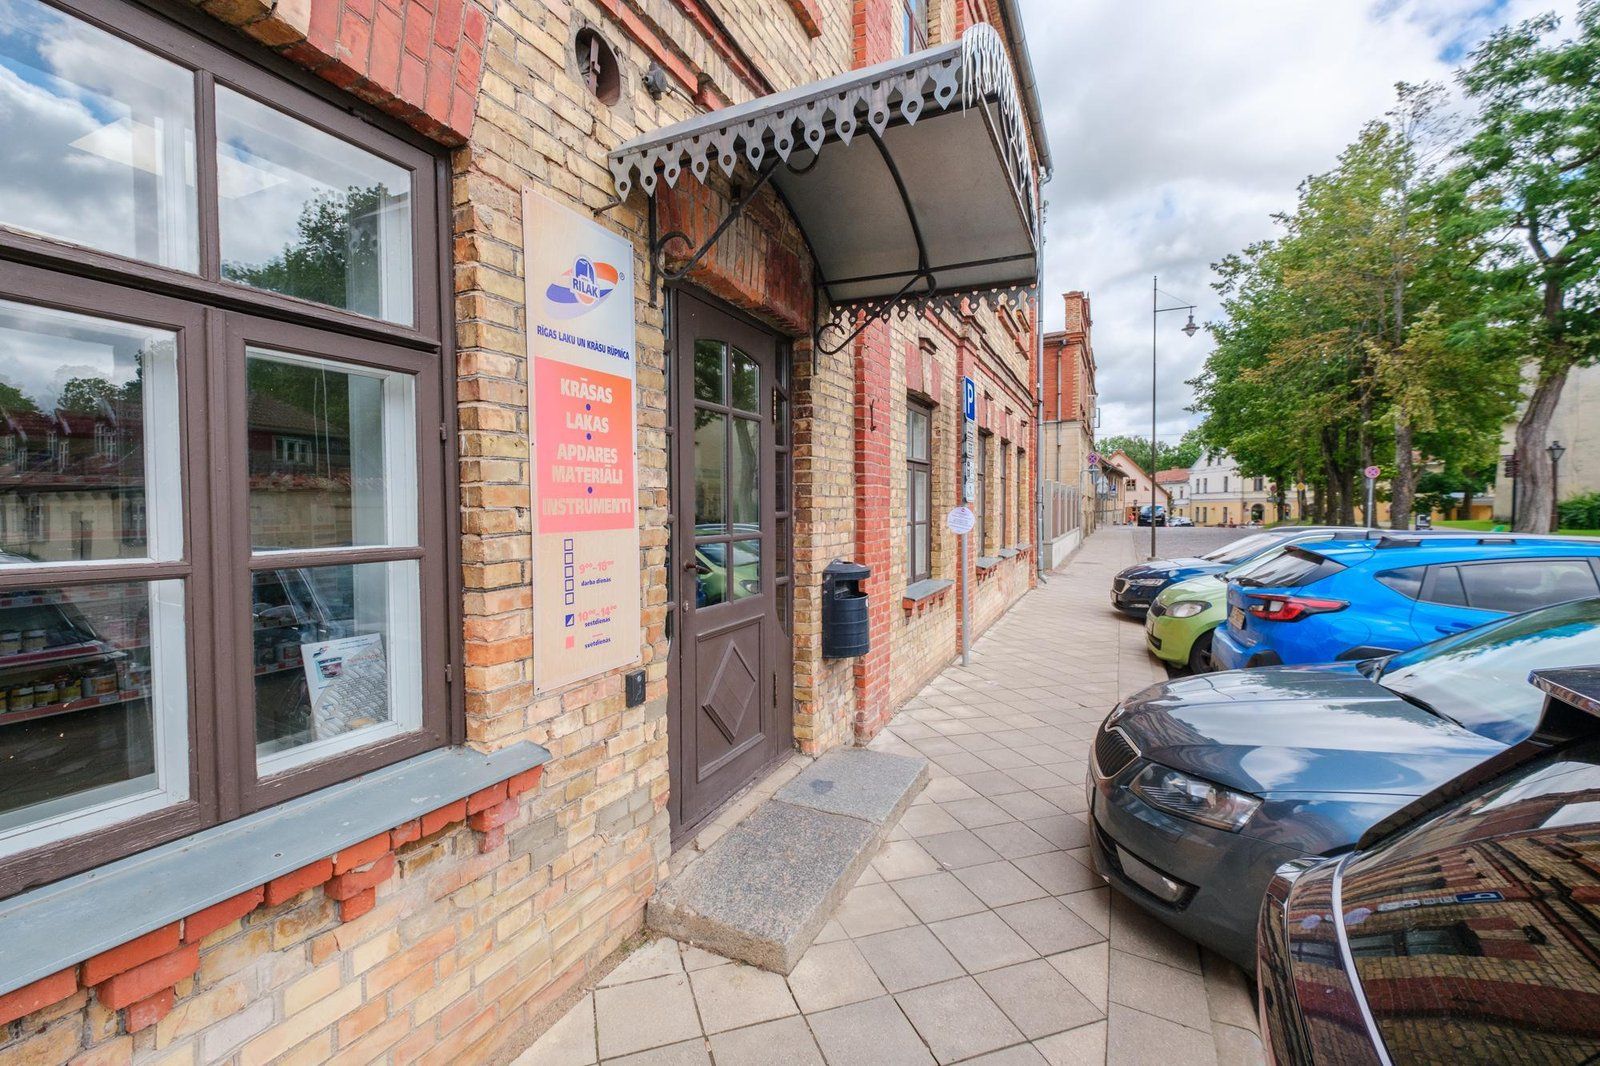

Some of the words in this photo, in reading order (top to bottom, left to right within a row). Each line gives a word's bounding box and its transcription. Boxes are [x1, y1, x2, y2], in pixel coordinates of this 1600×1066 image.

[572, 278, 599, 298] RILAK
[558, 332, 576, 345] LAKU
[577, 338, 586, 347] UN
[587, 340, 606, 354] KRĀSU
[560, 377, 613, 404] KRĀSAS
[967, 383, 974, 414] P
[566, 411, 610, 434] LAKAS
[556, 443, 618, 465] APDARES
[552, 464, 623, 484] MATERIĀLI
[542, 498, 632, 516] INSTRUMENTI
[581, 579, 596, 587] darba
